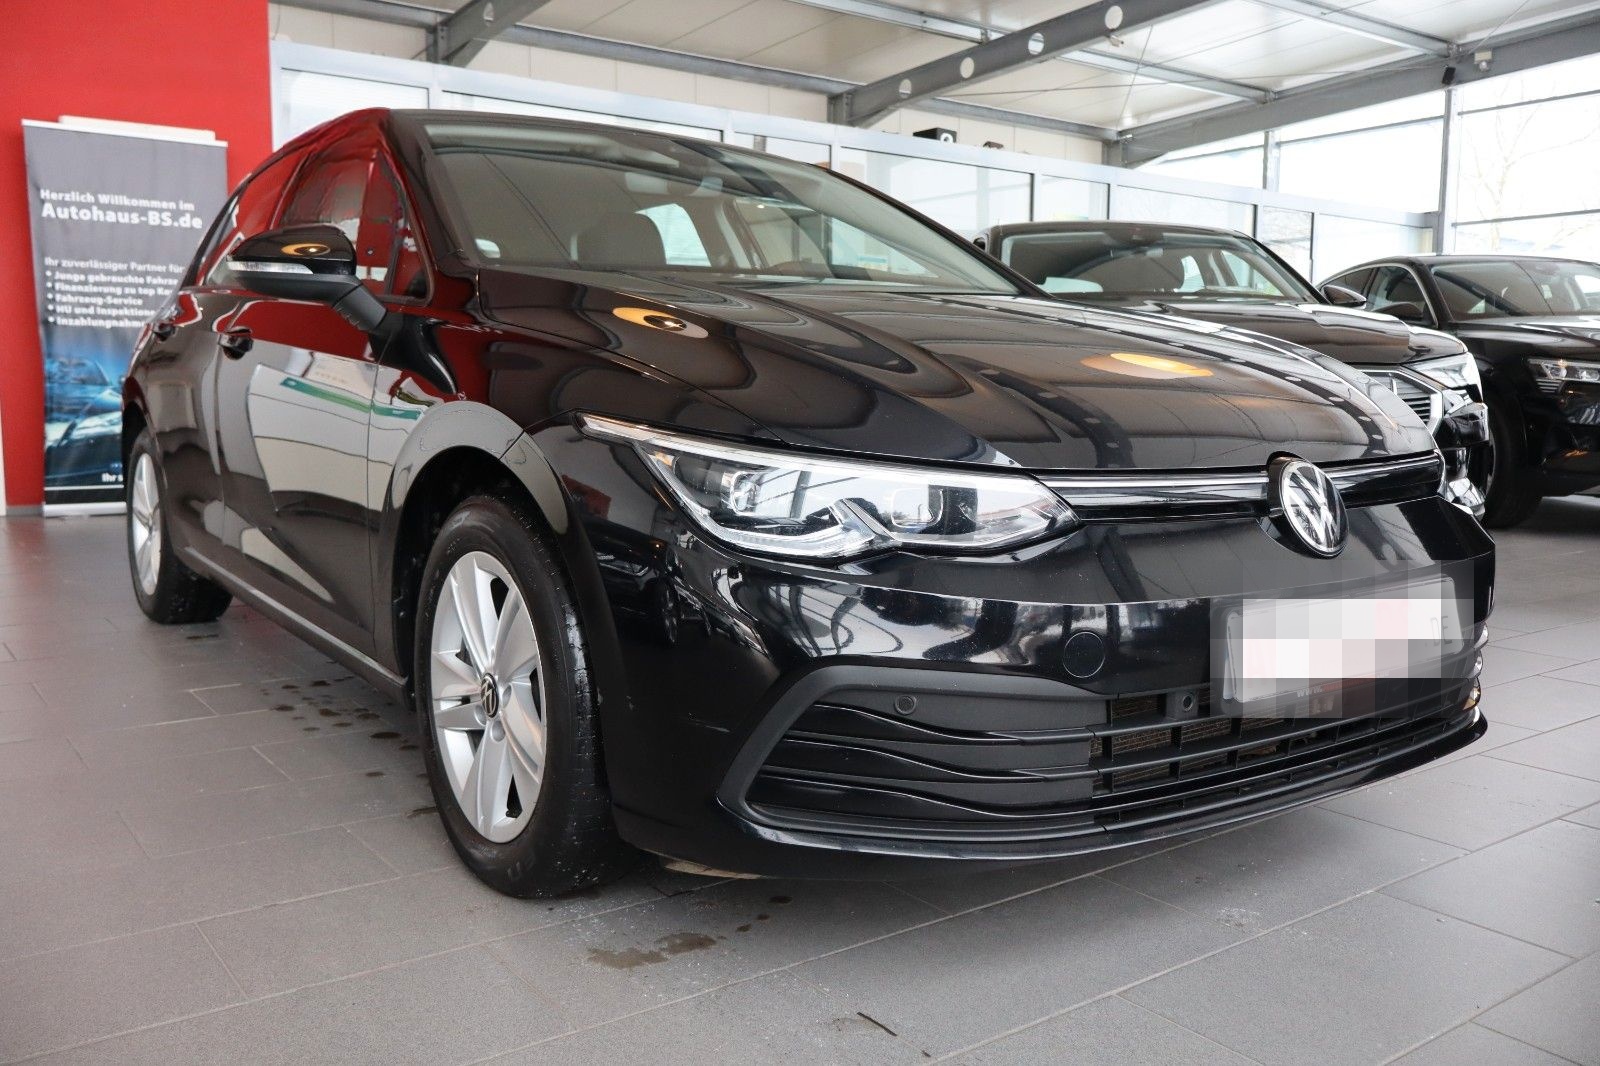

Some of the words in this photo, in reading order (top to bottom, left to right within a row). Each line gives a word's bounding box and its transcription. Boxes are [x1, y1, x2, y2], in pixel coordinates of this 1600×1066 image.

[40, 189, 95, 204] Herzlich
[97, 194, 177, 210] Willkommen
[178, 200, 195, 212] im
[41, 202, 203, 229] Autohaus-BS.de
[44, 257, 59, 267] Ihr
[61, 259, 128, 271] zuverlässiger
[129, 261, 167, 272] Partner
[54, 271, 86, 282] Junge
[87, 273, 145, 284] gebrauchte
[54, 282, 122, 295] Finanzierung
[123, 286, 137, 295] zu
[137, 287, 155, 297] top
[54, 292, 143, 305] Fahrzeug-Service
[55, 304, 72, 314] HU
[73, 306, 96, 315] und
